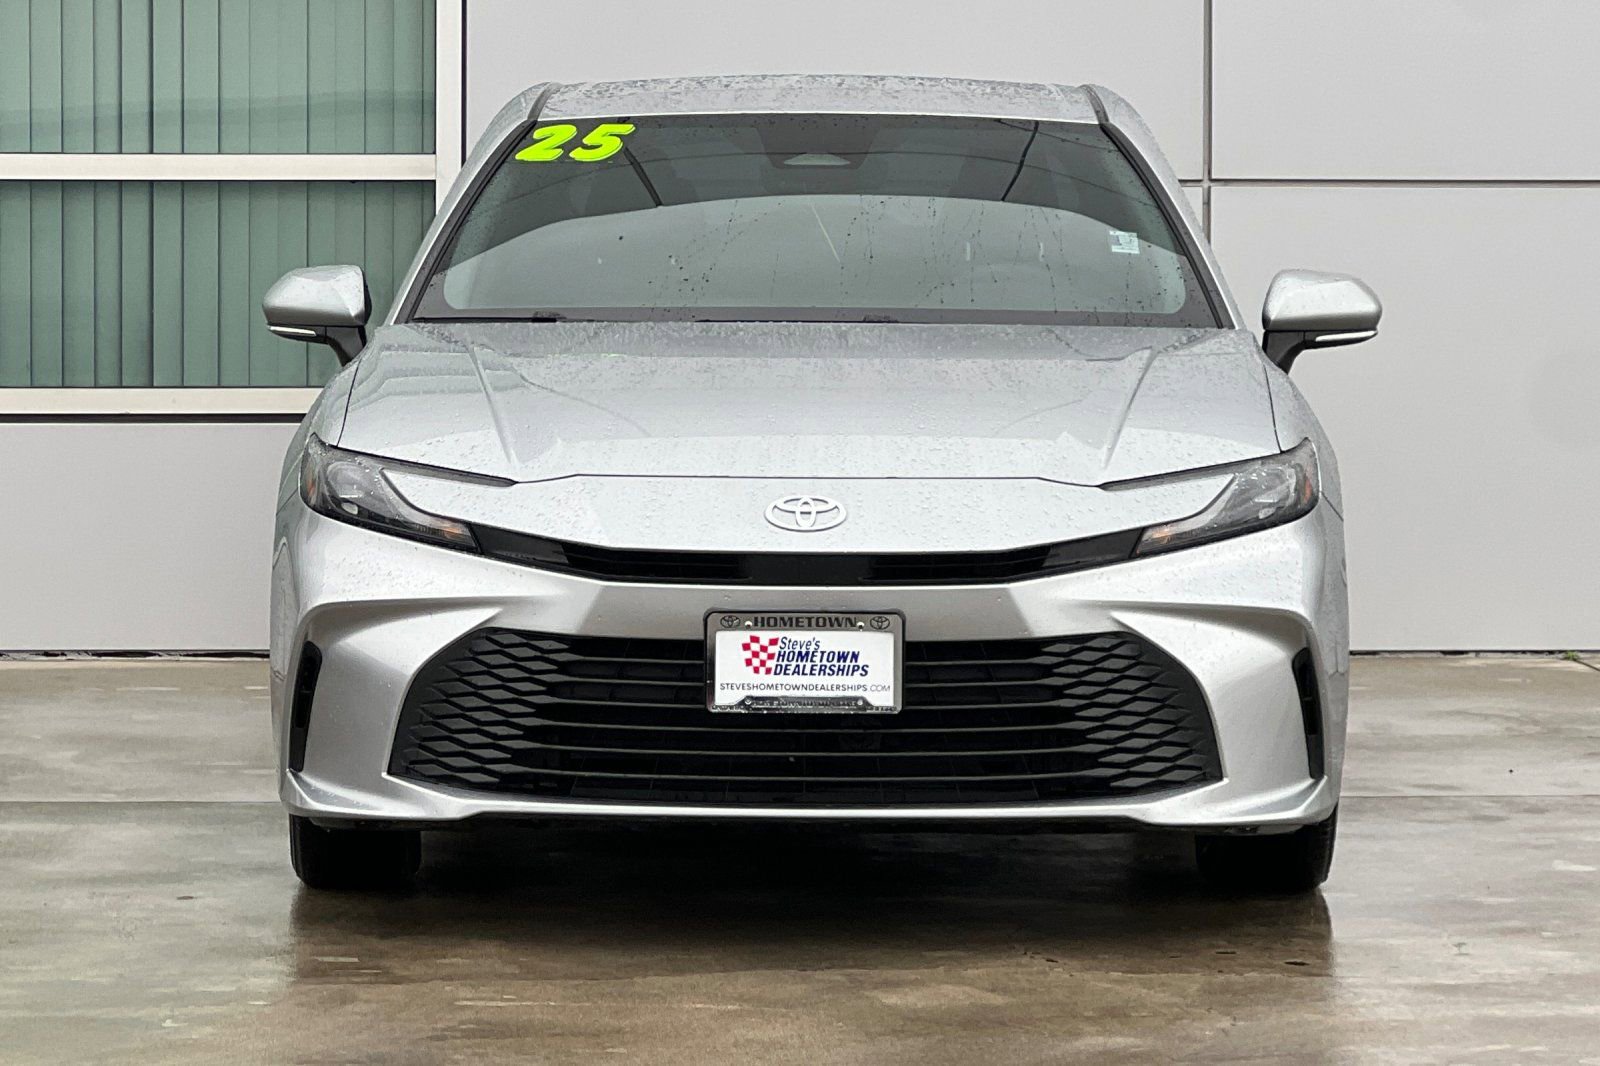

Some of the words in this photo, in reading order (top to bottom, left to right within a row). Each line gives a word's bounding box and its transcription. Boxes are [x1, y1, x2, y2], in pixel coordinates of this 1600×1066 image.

[514, 123, 636, 162] 25
[753, 616, 857, 628] HOMETOWN
[779, 636, 820, 651] Steve's
[776, 651, 860, 663] HOMETOWN
[773, 664, 869, 677] DEALERSHIPS
[719, 682, 891, 692] STEVESHOMETOWNDEALERSHIPS.COM
